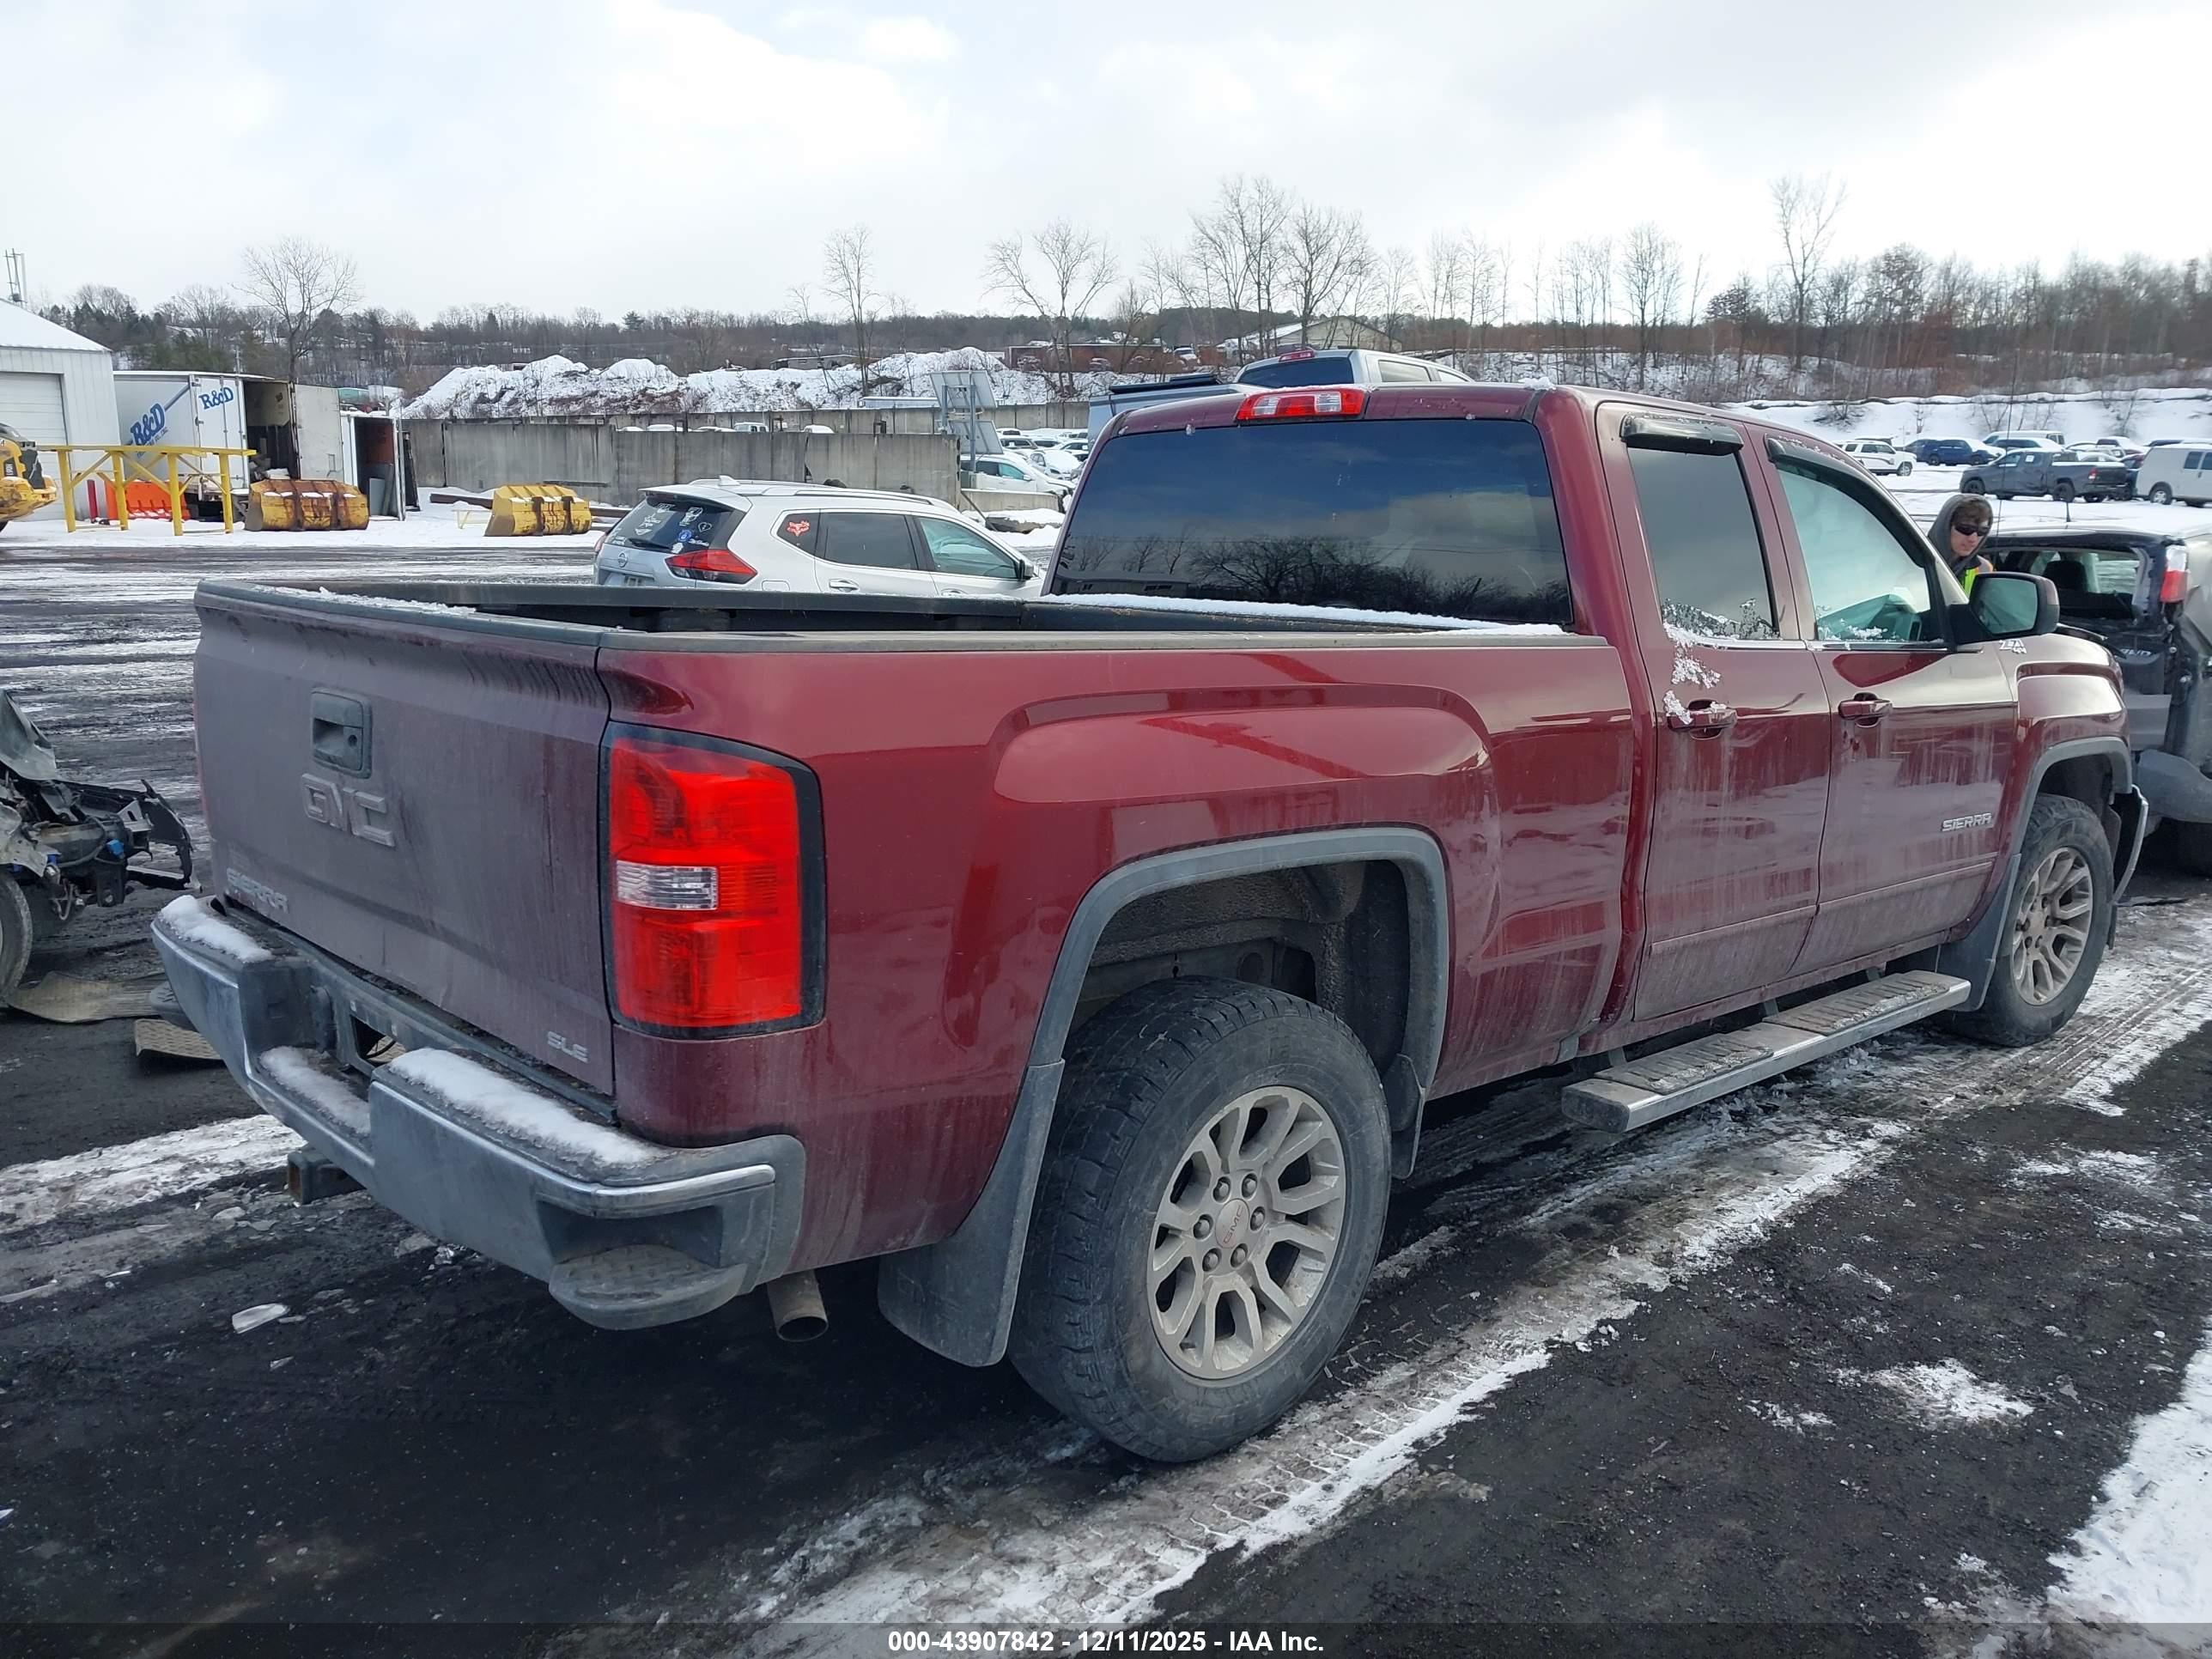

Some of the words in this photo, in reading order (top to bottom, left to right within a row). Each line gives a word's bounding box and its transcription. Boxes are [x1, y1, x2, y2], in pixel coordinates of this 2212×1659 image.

[198, 386, 234, 410] R&D
[131, 403, 166, 445] R&D
[301, 773, 395, 847] GMC
[1942, 812, 1992, 832] SIERRA
[226, 867, 289, 914] SIERRA
[547, 1030, 589, 1064] SLE
[1223, 1205, 1243, 1243] GMC
